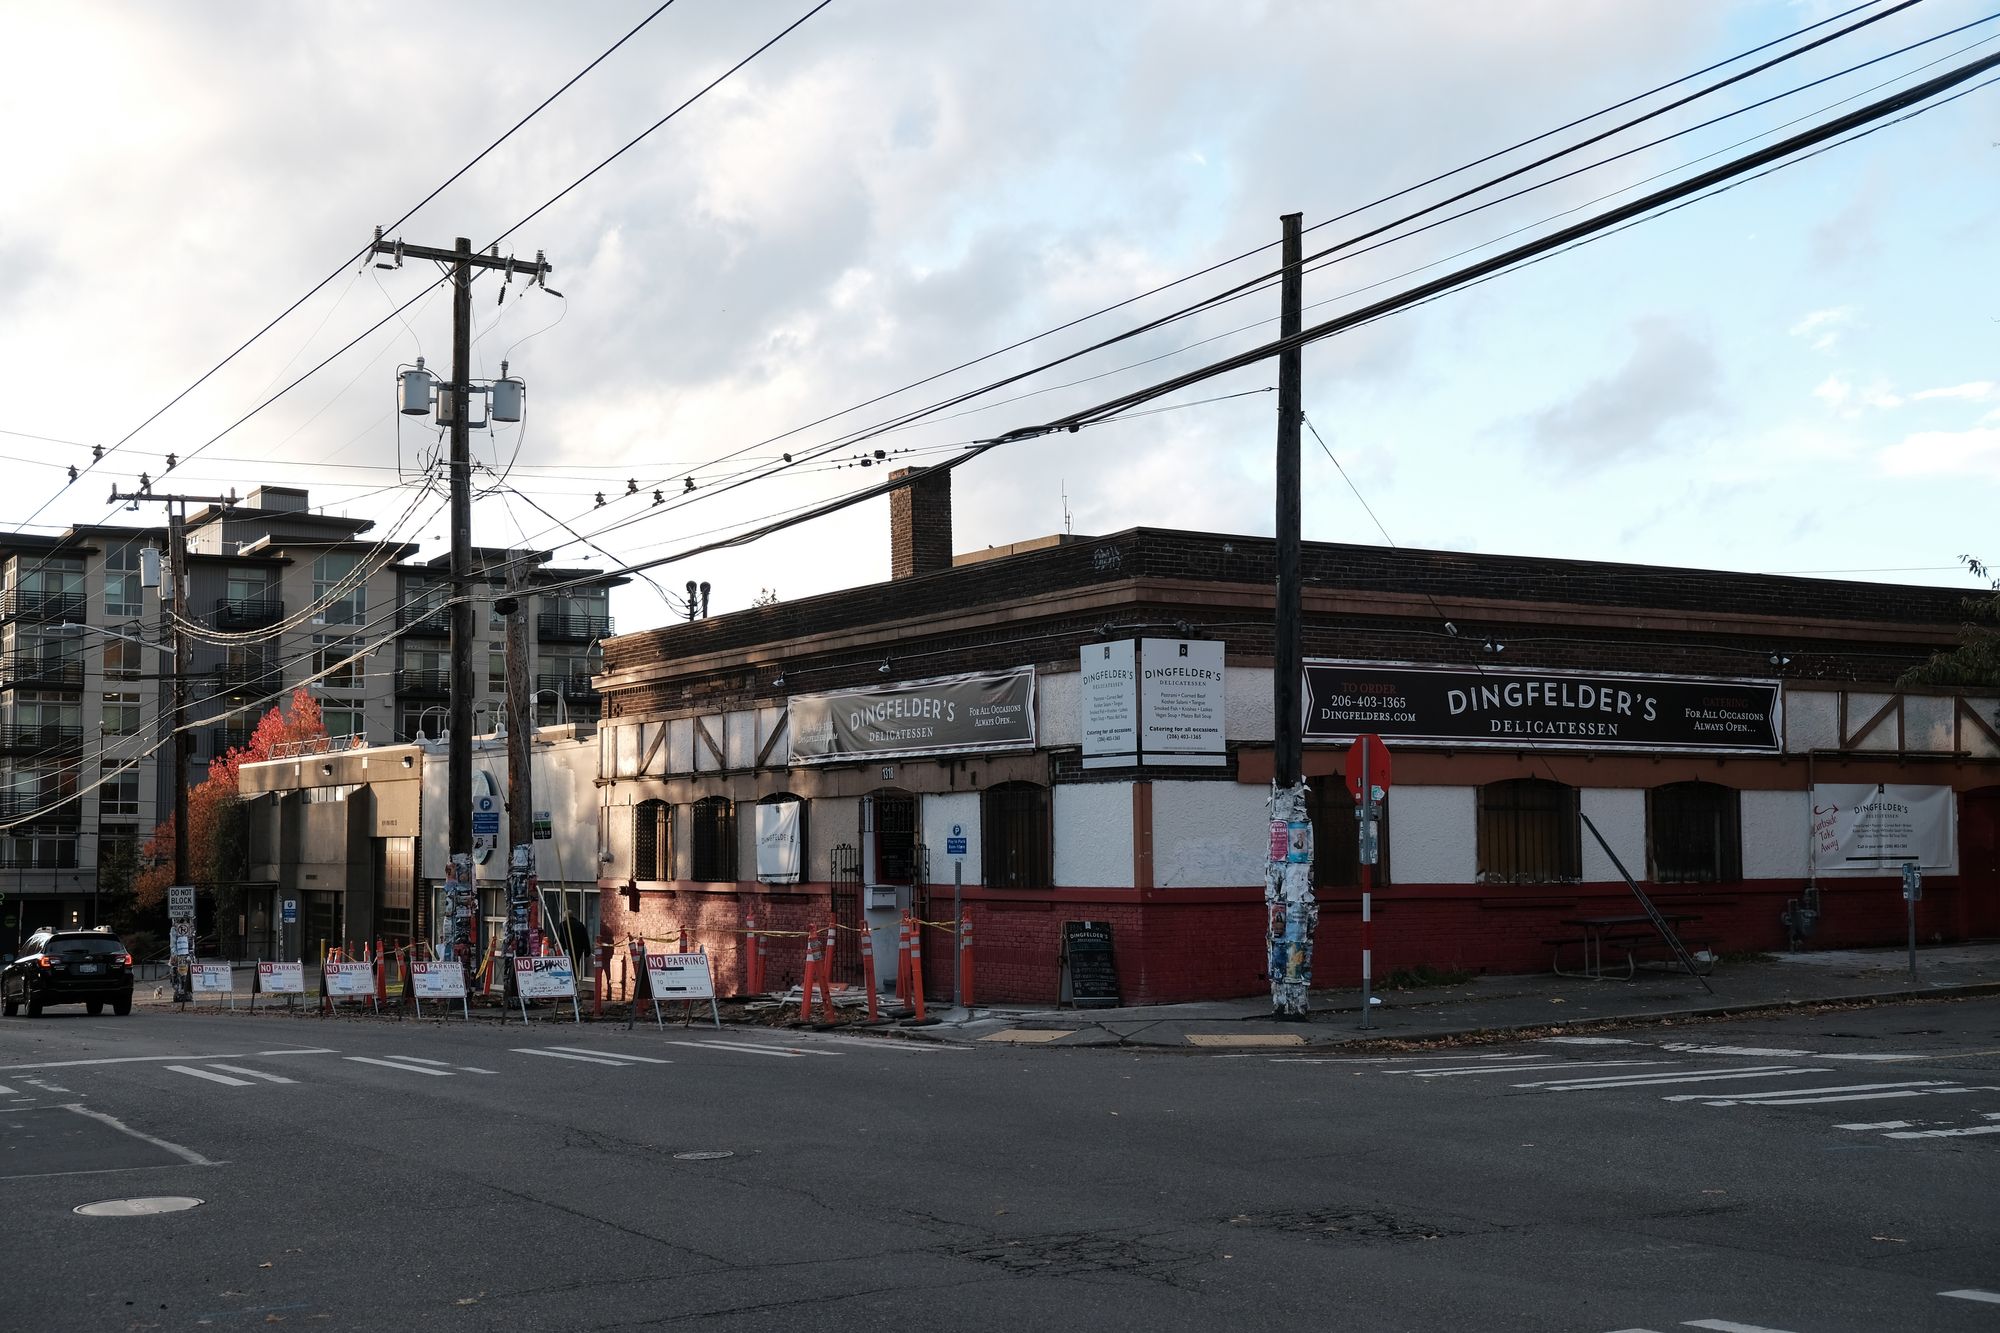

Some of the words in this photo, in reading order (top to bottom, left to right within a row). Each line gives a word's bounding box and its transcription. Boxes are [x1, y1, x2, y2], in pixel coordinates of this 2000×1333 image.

[1083, 670, 1134, 685] DINGFELDER'S
[1145, 667, 1221, 681] DINGFELDER'S
[1342, 682, 1358, 693] TO
[1360, 683, 1397, 694] ORDER
[1331, 695, 1406, 708] 206-403-1365
[1447, 682, 1658, 722] DINGFELDER'S
[850, 698, 955, 732] DINGFELDER'S
[1321, 708, 1416, 721] DINGFELDERS.COM
[1490, 719, 1618, 736] DELICATESSEN
[869, 727, 934, 742] DELICATESSEN
[1854, 802, 1908, 814] DINGFELDER'S
[1819, 829, 1835, 841] Take
[1821, 840, 1839, 853] Away
[414, 964, 426, 972] NO
[517, 960, 530, 969] NO
[649, 957, 663, 968] NO
[668, 956, 705, 965] PARKING
